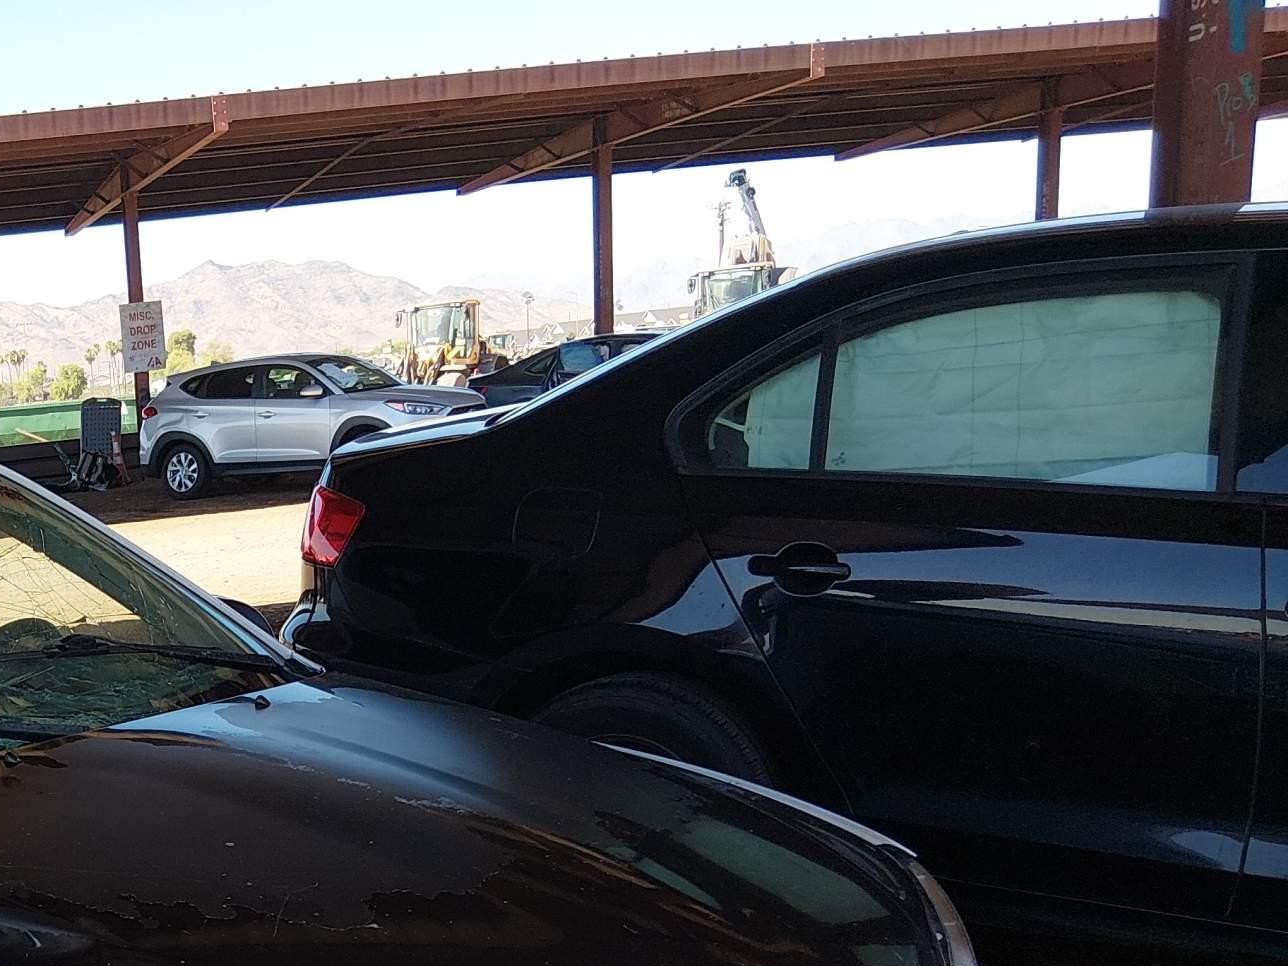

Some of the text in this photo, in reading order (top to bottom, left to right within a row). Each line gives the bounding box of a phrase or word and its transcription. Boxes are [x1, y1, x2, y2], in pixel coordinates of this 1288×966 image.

[128, 311, 154, 321] MISC.
[129, 324, 156, 336] DROP
[131, 338, 157, 351] ZONE
